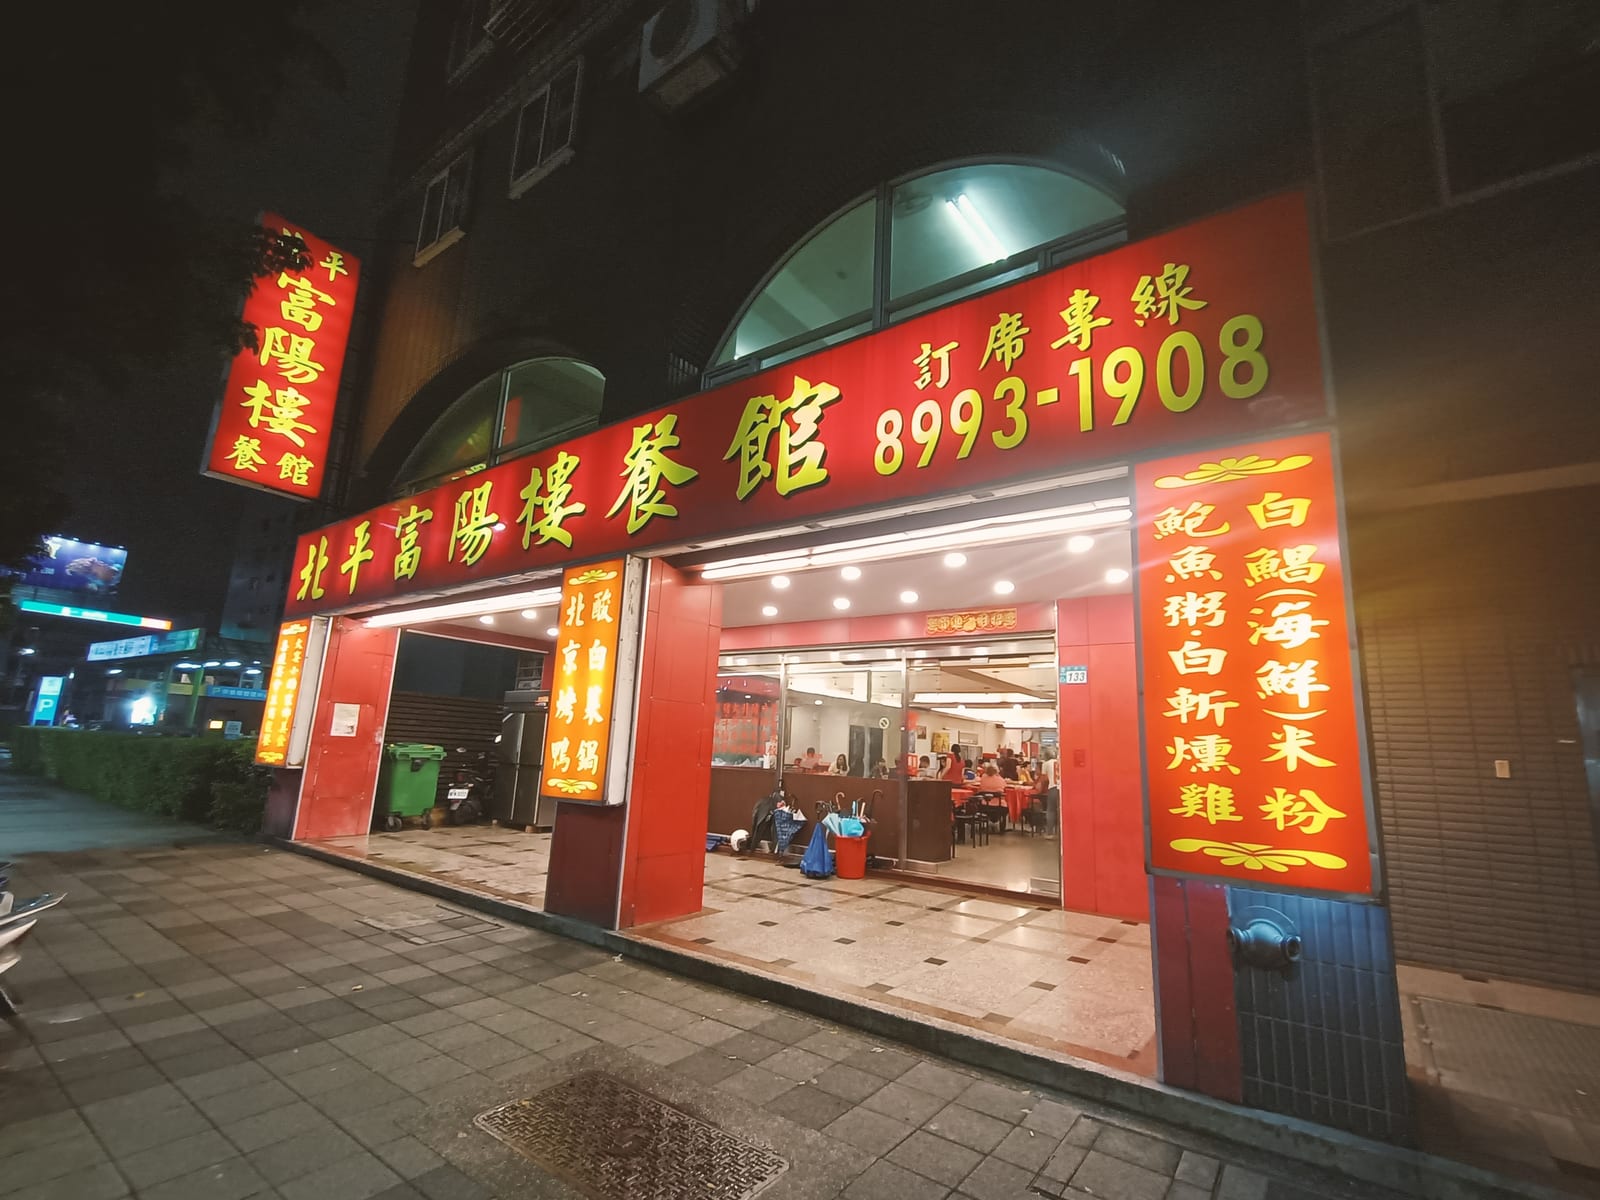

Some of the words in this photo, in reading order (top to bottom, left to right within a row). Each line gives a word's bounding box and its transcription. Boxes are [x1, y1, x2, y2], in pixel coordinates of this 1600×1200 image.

[240, 271, 336, 447] 富陽樓
[873, 314, 1268, 476] 8993-1908
[913, 263, 1208, 391] 訂席專線
[224, 434, 315, 486] 餐館
[297, 375, 840, 600] 北平富陽樓餐館
[39, 699, 54, 712] P
[551, 592, 585, 773] 北京烤鴨
[576, 588, 614, 776] 酸白菜鍋
[1067, 672, 1085, 682] 133
